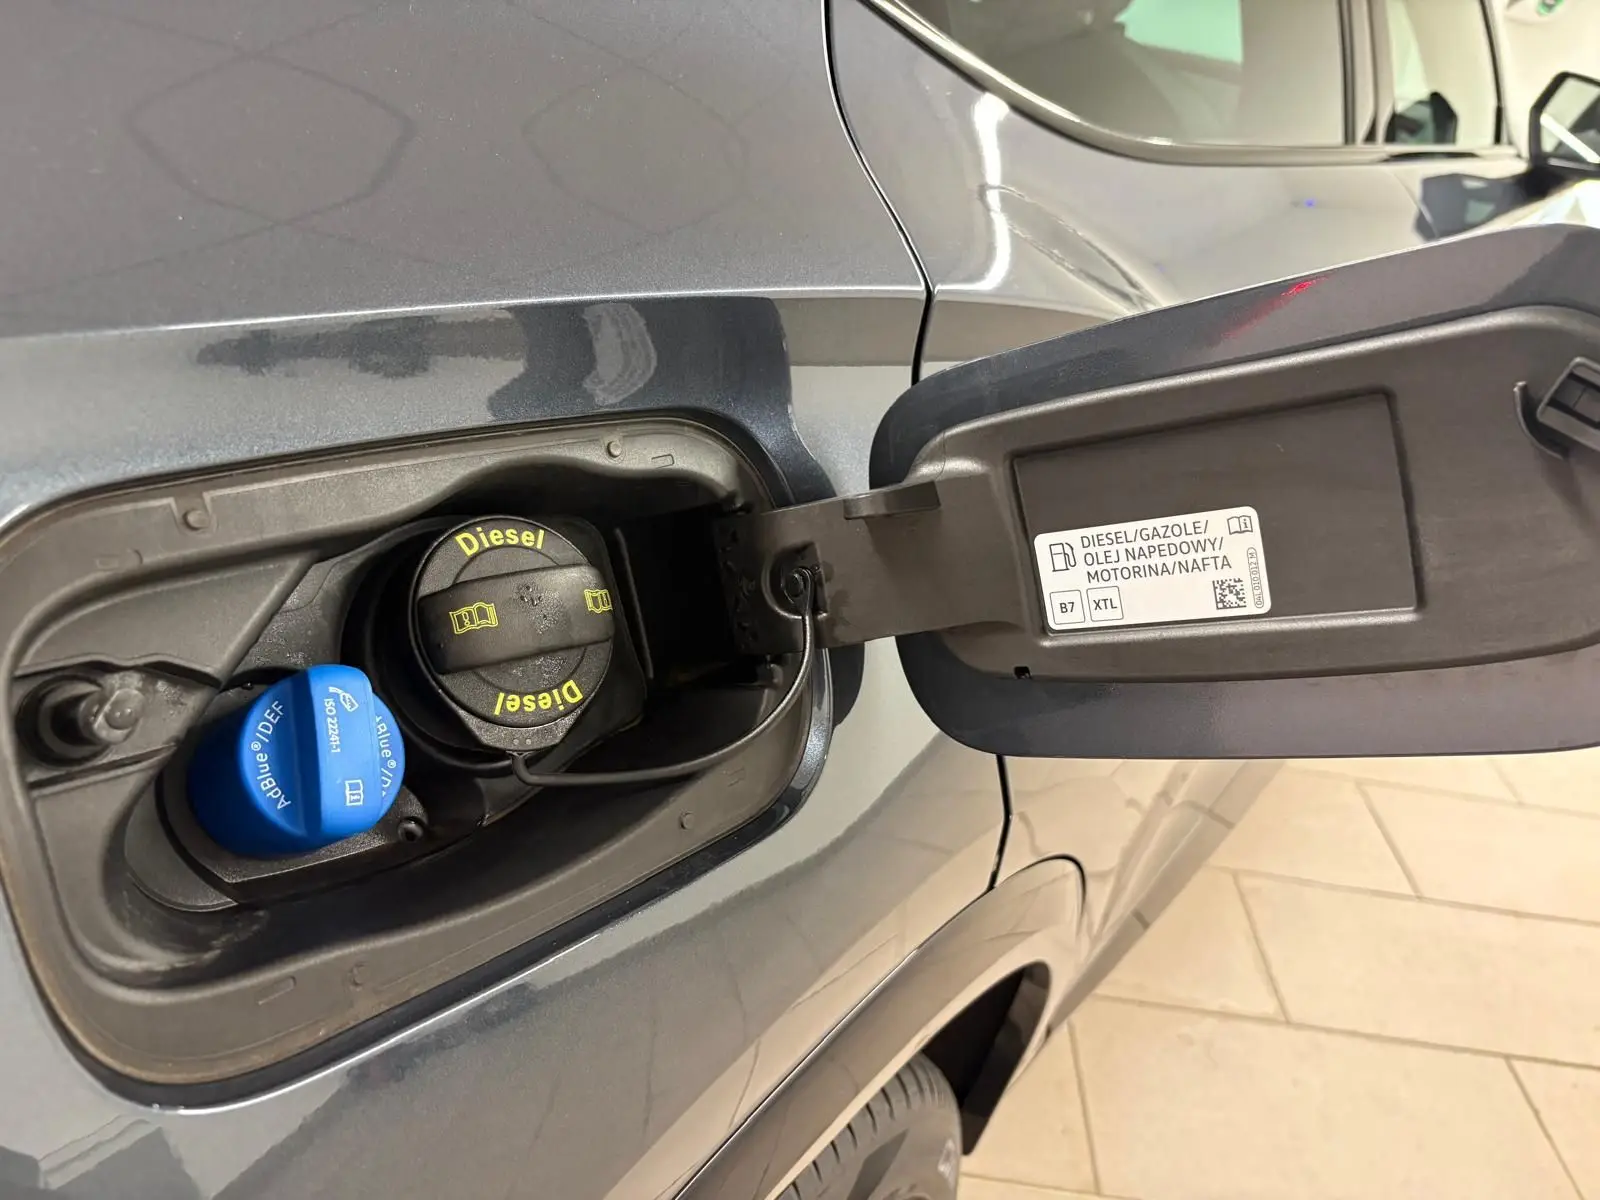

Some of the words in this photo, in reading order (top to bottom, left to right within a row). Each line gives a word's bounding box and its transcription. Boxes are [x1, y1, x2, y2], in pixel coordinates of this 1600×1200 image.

[455, 526, 546, 557] Diesel
[1080, 519, 1209, 549] DIESEL/GAZOLE/
[1083, 551, 1121, 567] OLEJ
[1125, 536, 1224, 562] NAPEDOWY/
[1086, 555, 1232, 584] MOTORINA/NAFTA
[1059, 601, 1075, 614] B7
[1092, 598, 1118, 611] XTL
[323, 698, 336, 717] ISO
[493, 679, 584, 716] Diesel
[325, 717, 341, 753] 22241-1
